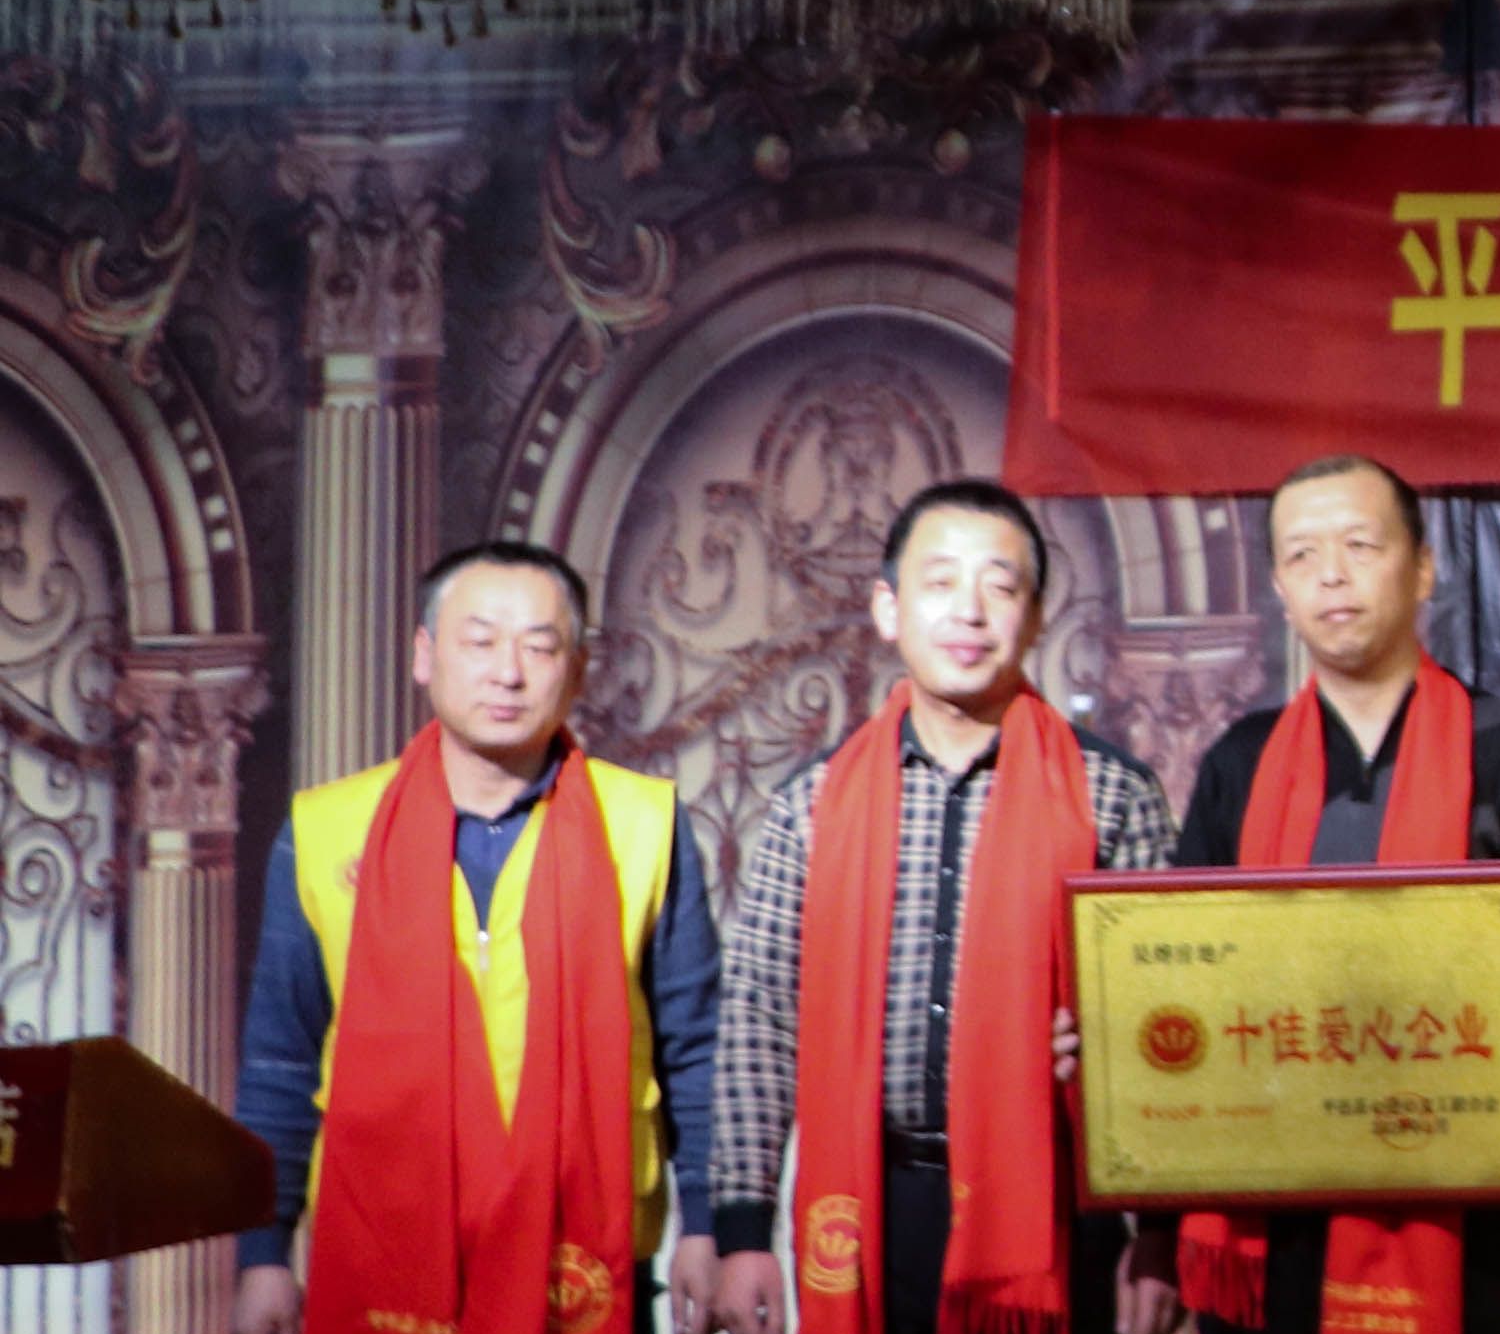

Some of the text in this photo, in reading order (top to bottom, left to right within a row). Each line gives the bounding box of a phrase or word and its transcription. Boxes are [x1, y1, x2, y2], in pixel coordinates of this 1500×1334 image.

[1222, 1003, 1494, 1066] 十佳爱心企业
